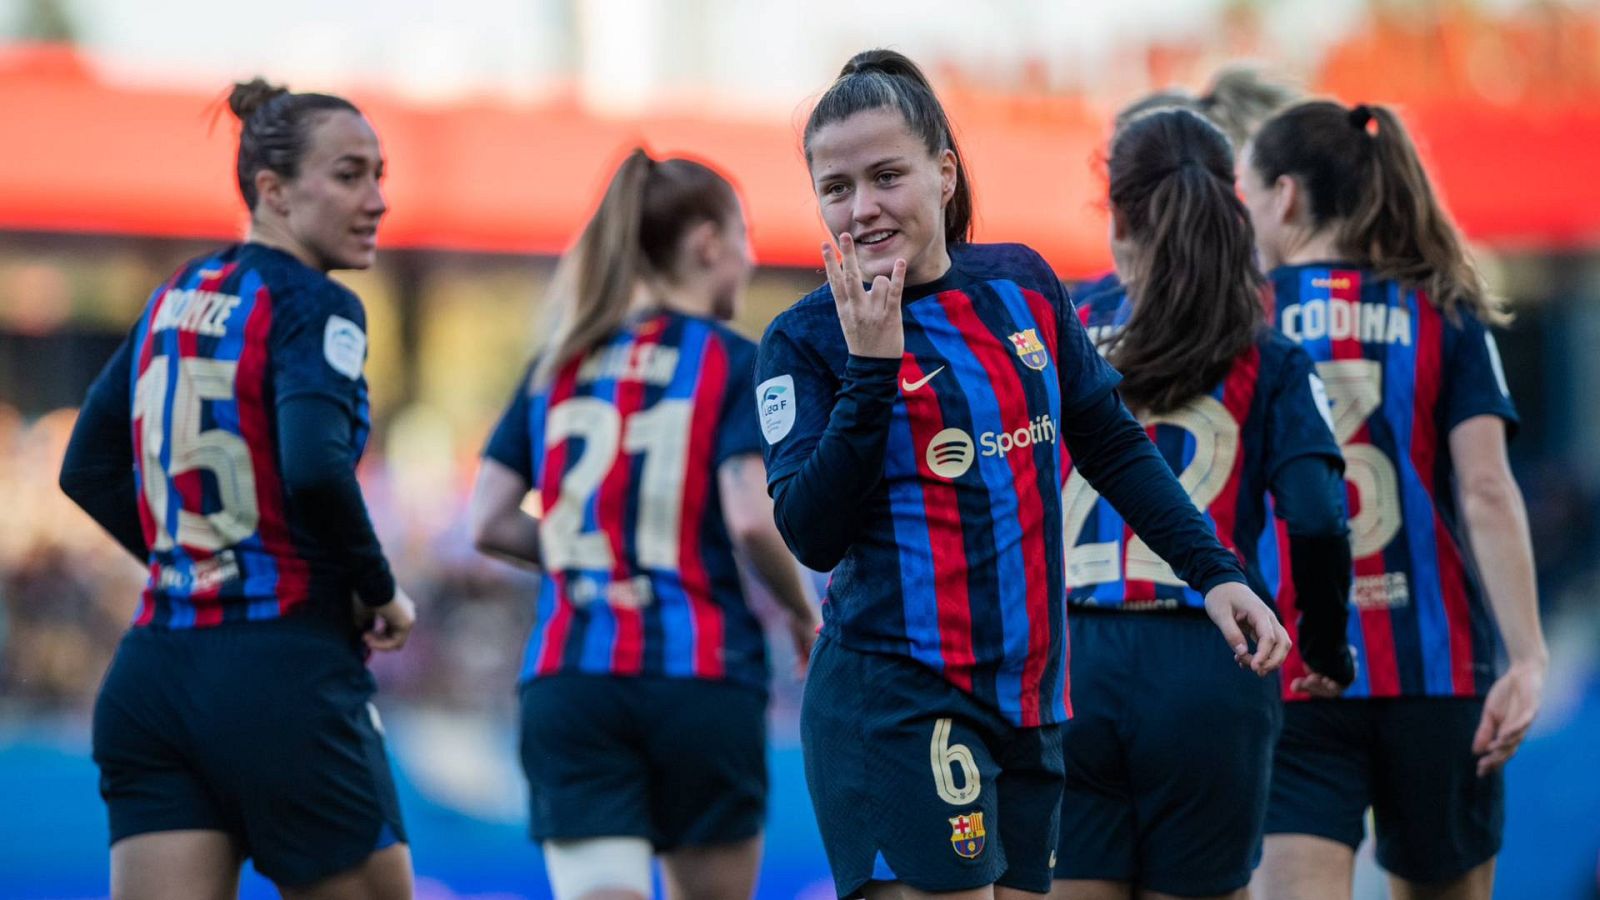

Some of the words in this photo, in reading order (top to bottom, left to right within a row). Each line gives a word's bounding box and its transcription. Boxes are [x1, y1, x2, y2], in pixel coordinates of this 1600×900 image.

[1281, 298, 1411, 346] CODINA
[133, 355, 260, 551] 15
[980, 414, 1057, 458] Spotify
[539, 395, 697, 572] 21
[930, 718, 981, 805] 6
